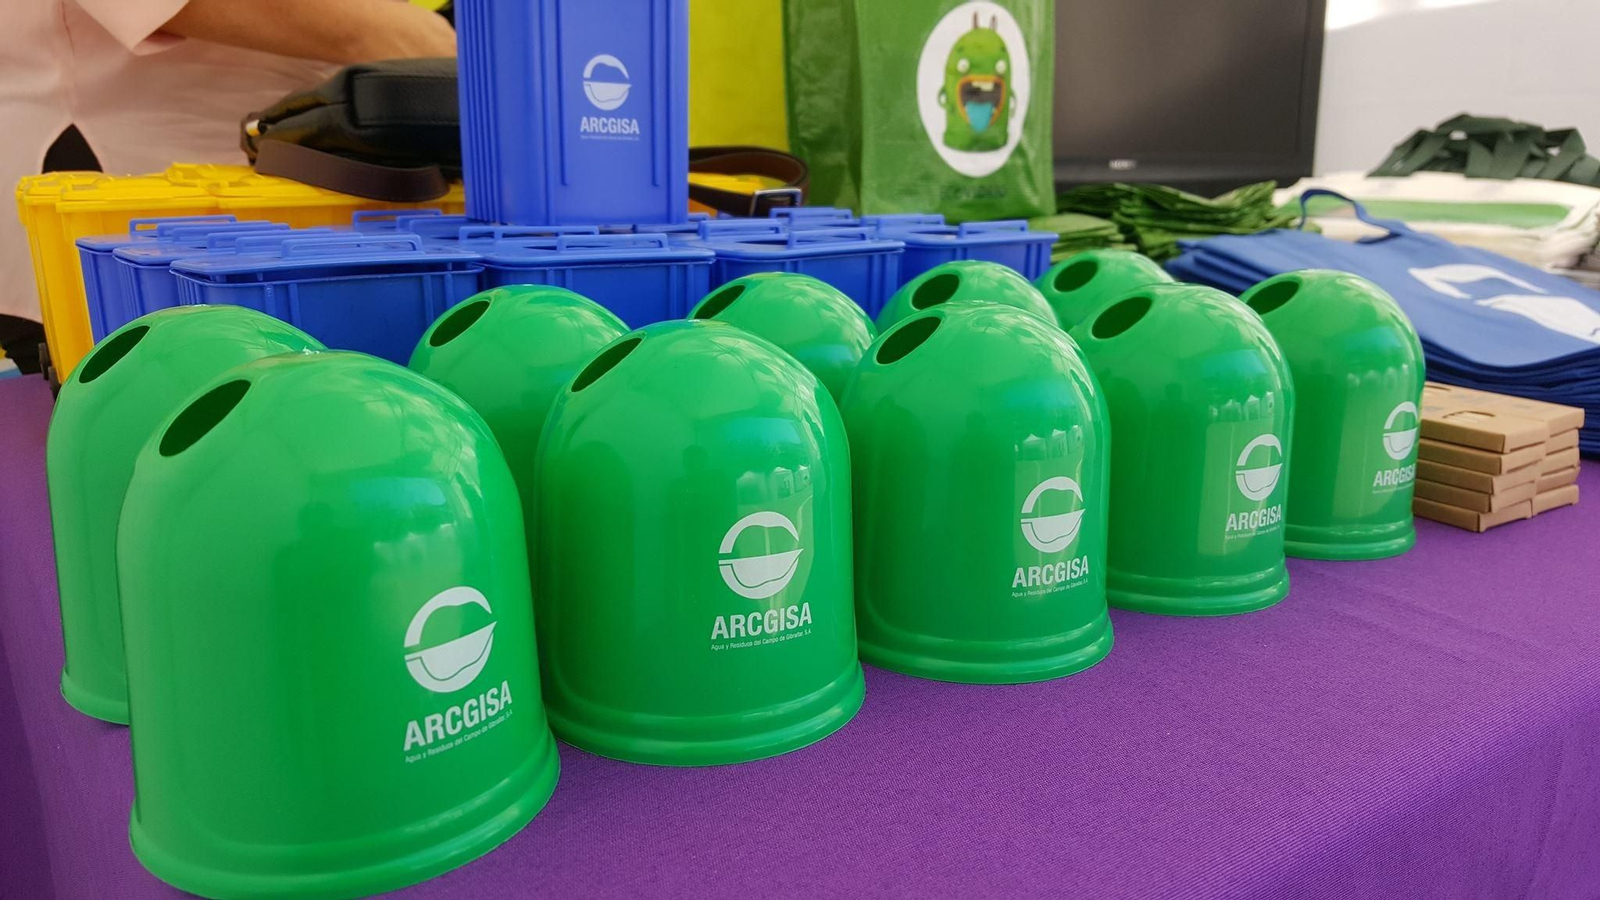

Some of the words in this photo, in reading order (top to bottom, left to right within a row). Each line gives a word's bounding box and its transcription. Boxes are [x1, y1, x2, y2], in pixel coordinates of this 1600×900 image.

[580, 116, 640, 135] ARCGISA
[1225, 503, 1282, 532] ARCGISA
[1011, 554, 1089, 588] ARCGISA
[711, 602, 812, 640] ARCGISA
[730, 641, 753, 649] Residuos
[762, 636, 779, 645] Campo
[403, 680, 513, 751] ARCGISA
[405, 753, 421, 763] Agua
[463, 729, 481, 741] Campo
